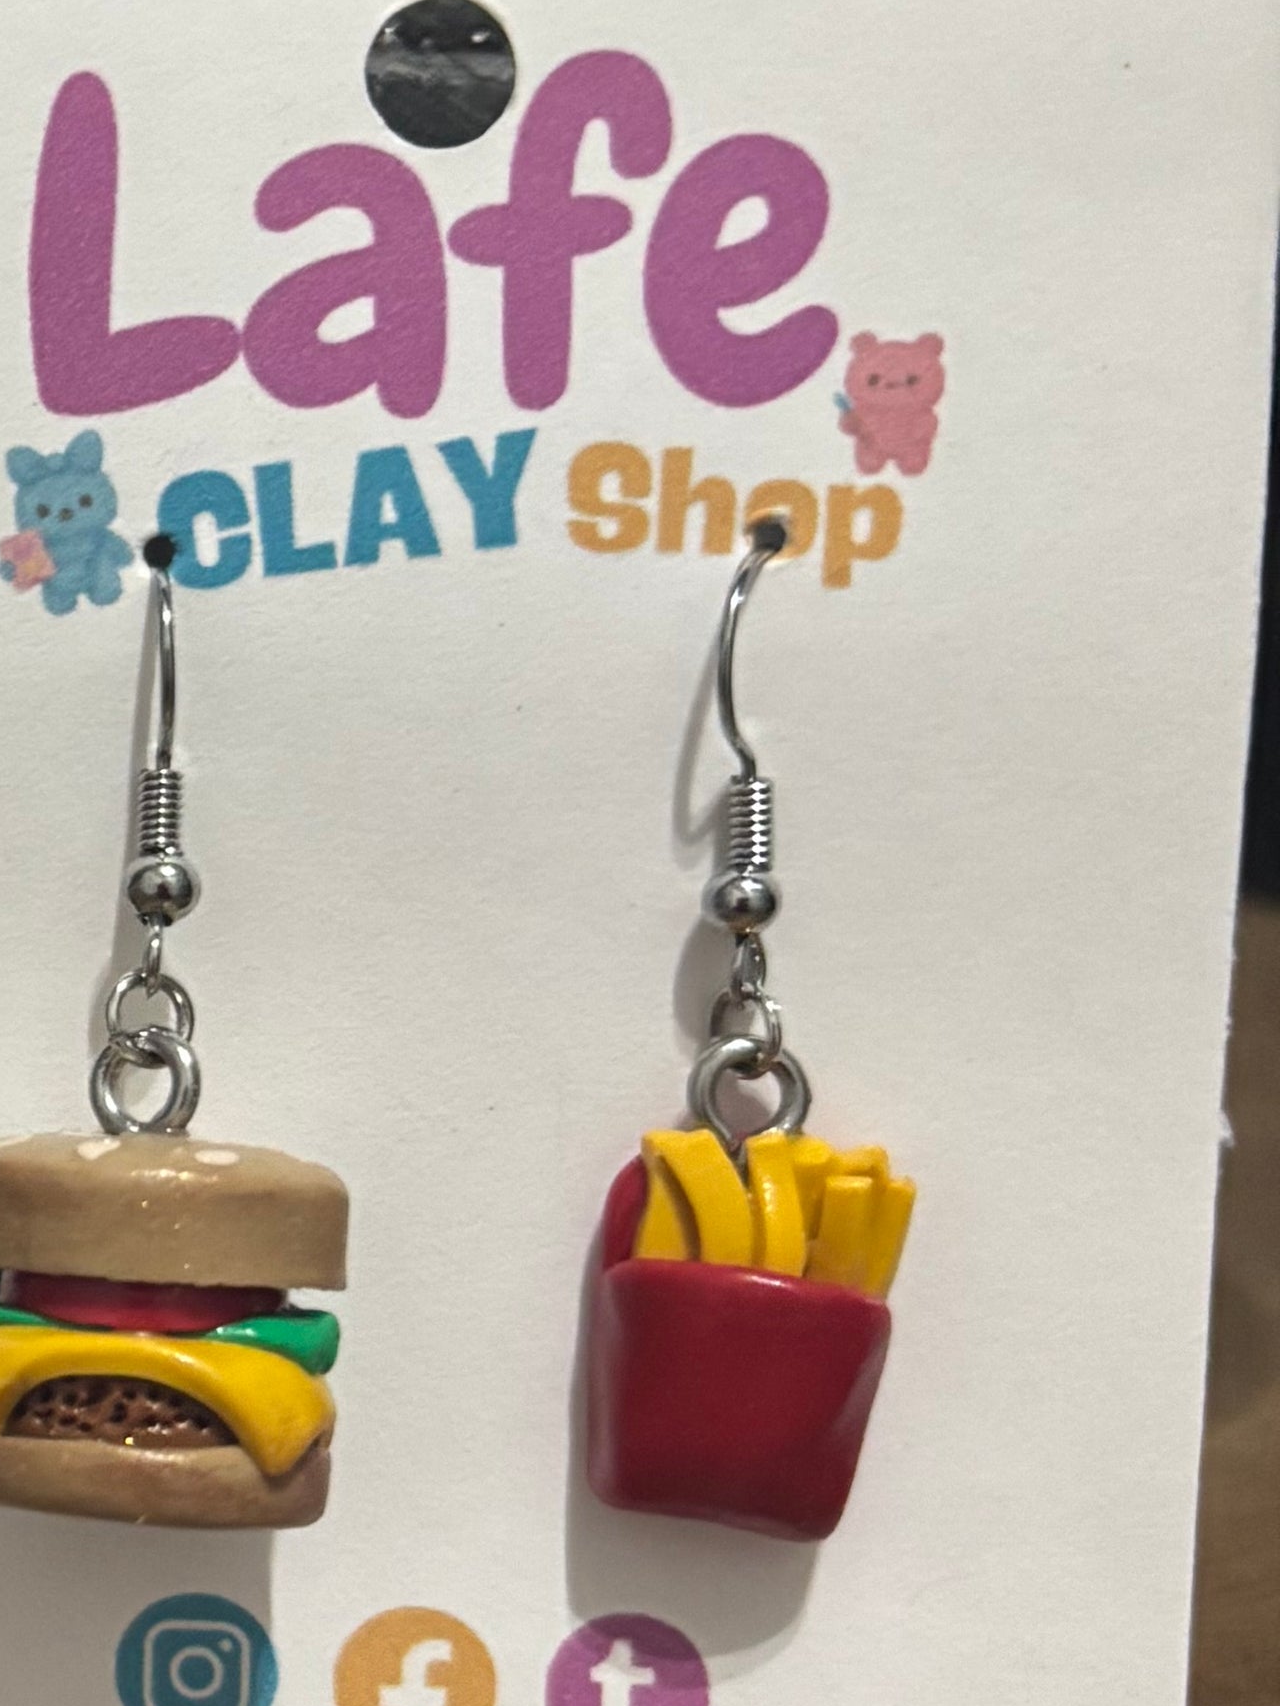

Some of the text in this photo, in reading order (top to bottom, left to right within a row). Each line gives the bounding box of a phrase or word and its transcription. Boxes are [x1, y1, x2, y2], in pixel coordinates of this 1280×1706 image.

[30, 50, 839, 418] Lafe
[156, 428, 903, 590] CLAY Shop
